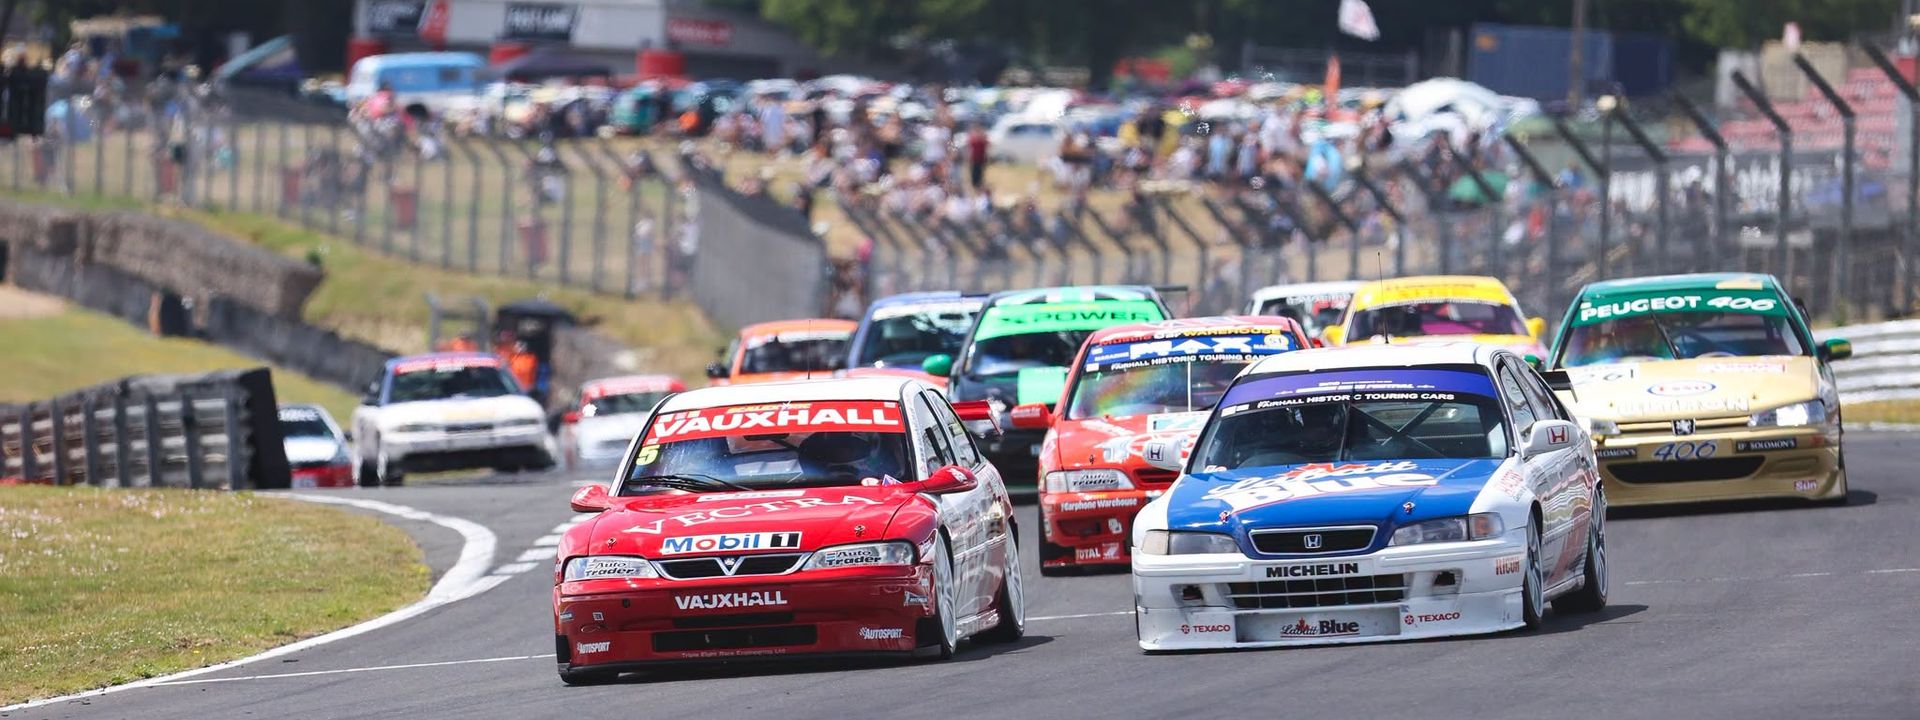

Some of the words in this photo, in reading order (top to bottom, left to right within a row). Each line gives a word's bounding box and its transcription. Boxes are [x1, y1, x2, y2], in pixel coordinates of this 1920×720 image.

[1580, 294, 1702, 321] PEUGEOT
[1707, 296, 1777, 311] 406
[1110, 360, 1150, 371] FAIRHALL
[1151, 354, 1196, 365] HISTORIC
[1199, 353, 1244, 362] TOURING
[1257, 398, 1305, 409] FAIRHALL
[1306, 393, 1361, 404] HISTORC
[1365, 391, 1419, 400] TOURING
[1420, 391, 1455, 401] CARS
[653, 407, 899, 439] VAUXHALL
[635, 444, 660, 466] 5
[1653, 441, 1717, 461] 406
[1202, 473, 1438, 514] Blue
[621, 494, 886, 535] VECTRA
[665, 533, 761, 552] Mobil
[776, 533, 795, 548] 1
[827, 556, 882, 566] Trader
[835, 550, 872, 558] Auto
[1076, 547, 1101, 560] TOTAL
[585, 567, 635, 577] Trader
[595, 561, 627, 569] Auto
[1266, 562, 1359, 578] MICHELIN
[675, 591, 788, 610] VAUXHALL
[1418, 612, 1461, 623] TEXACO
[864, 628, 903, 639] AUTOSPORT
[1193, 624, 1231, 633] TEXACO
[1319, 620, 1360, 635] Blue
[579, 641, 611, 655] AUTOSPORT
